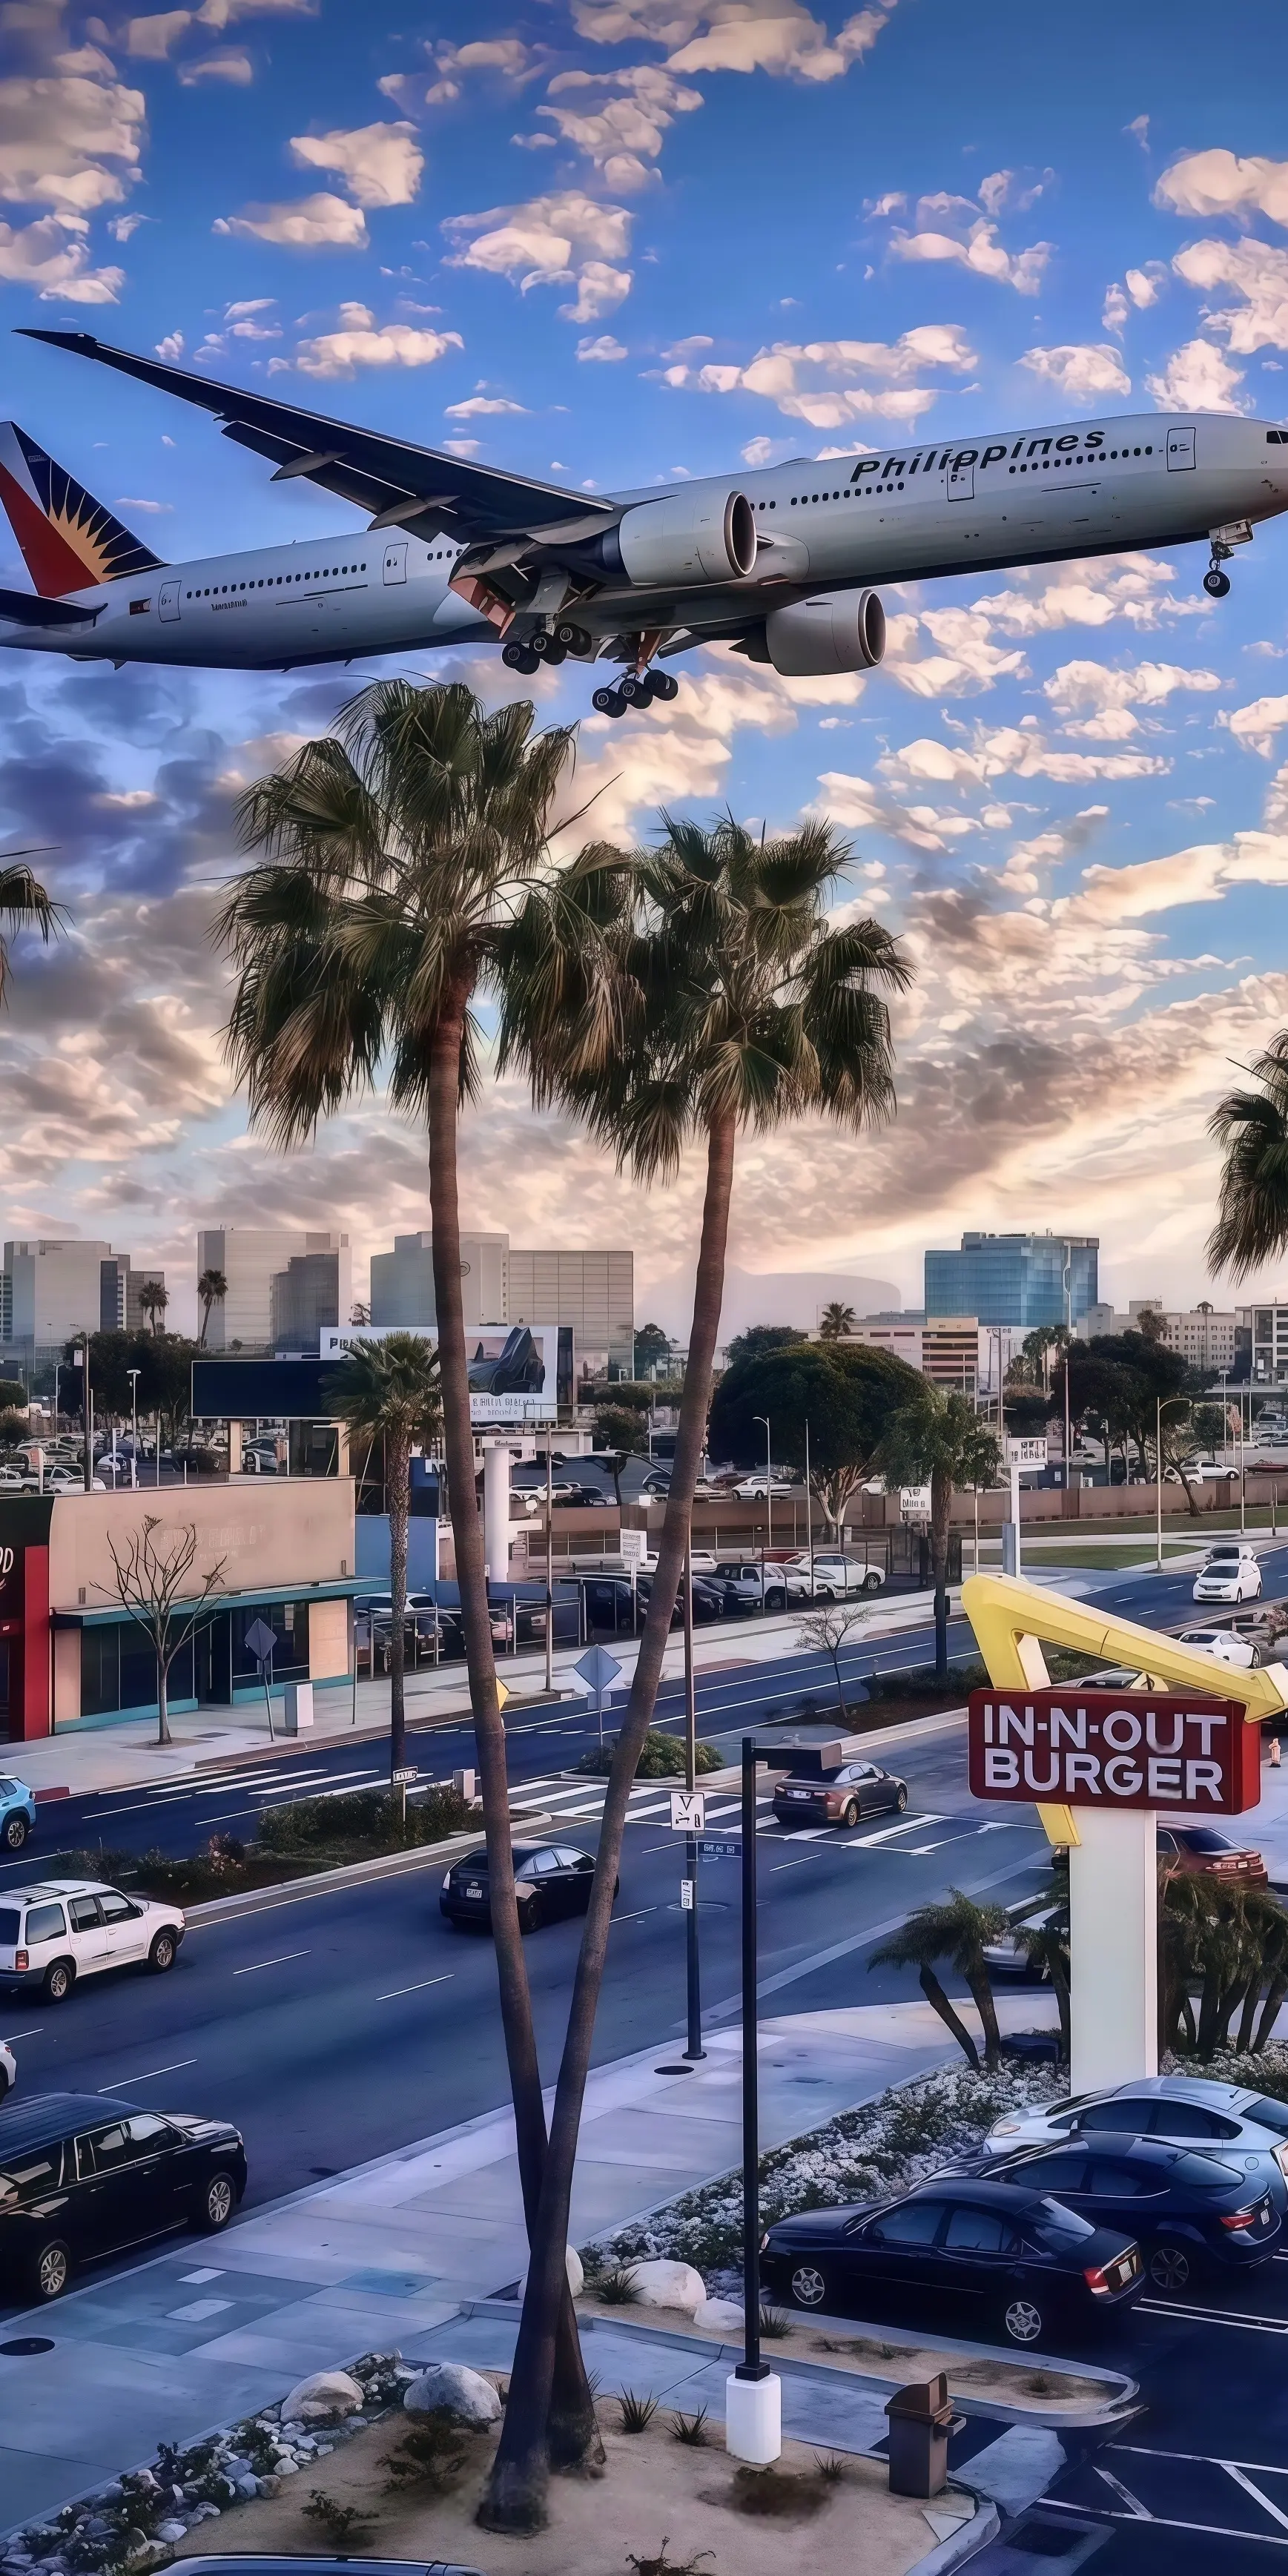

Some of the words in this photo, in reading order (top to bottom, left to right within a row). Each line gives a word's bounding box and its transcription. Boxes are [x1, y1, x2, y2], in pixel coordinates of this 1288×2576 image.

[850, 431, 1106, 483] Philippines
[984, 1704, 1227, 1756] IN-N-OUT
[985, 1748, 1223, 1802] BURGER
